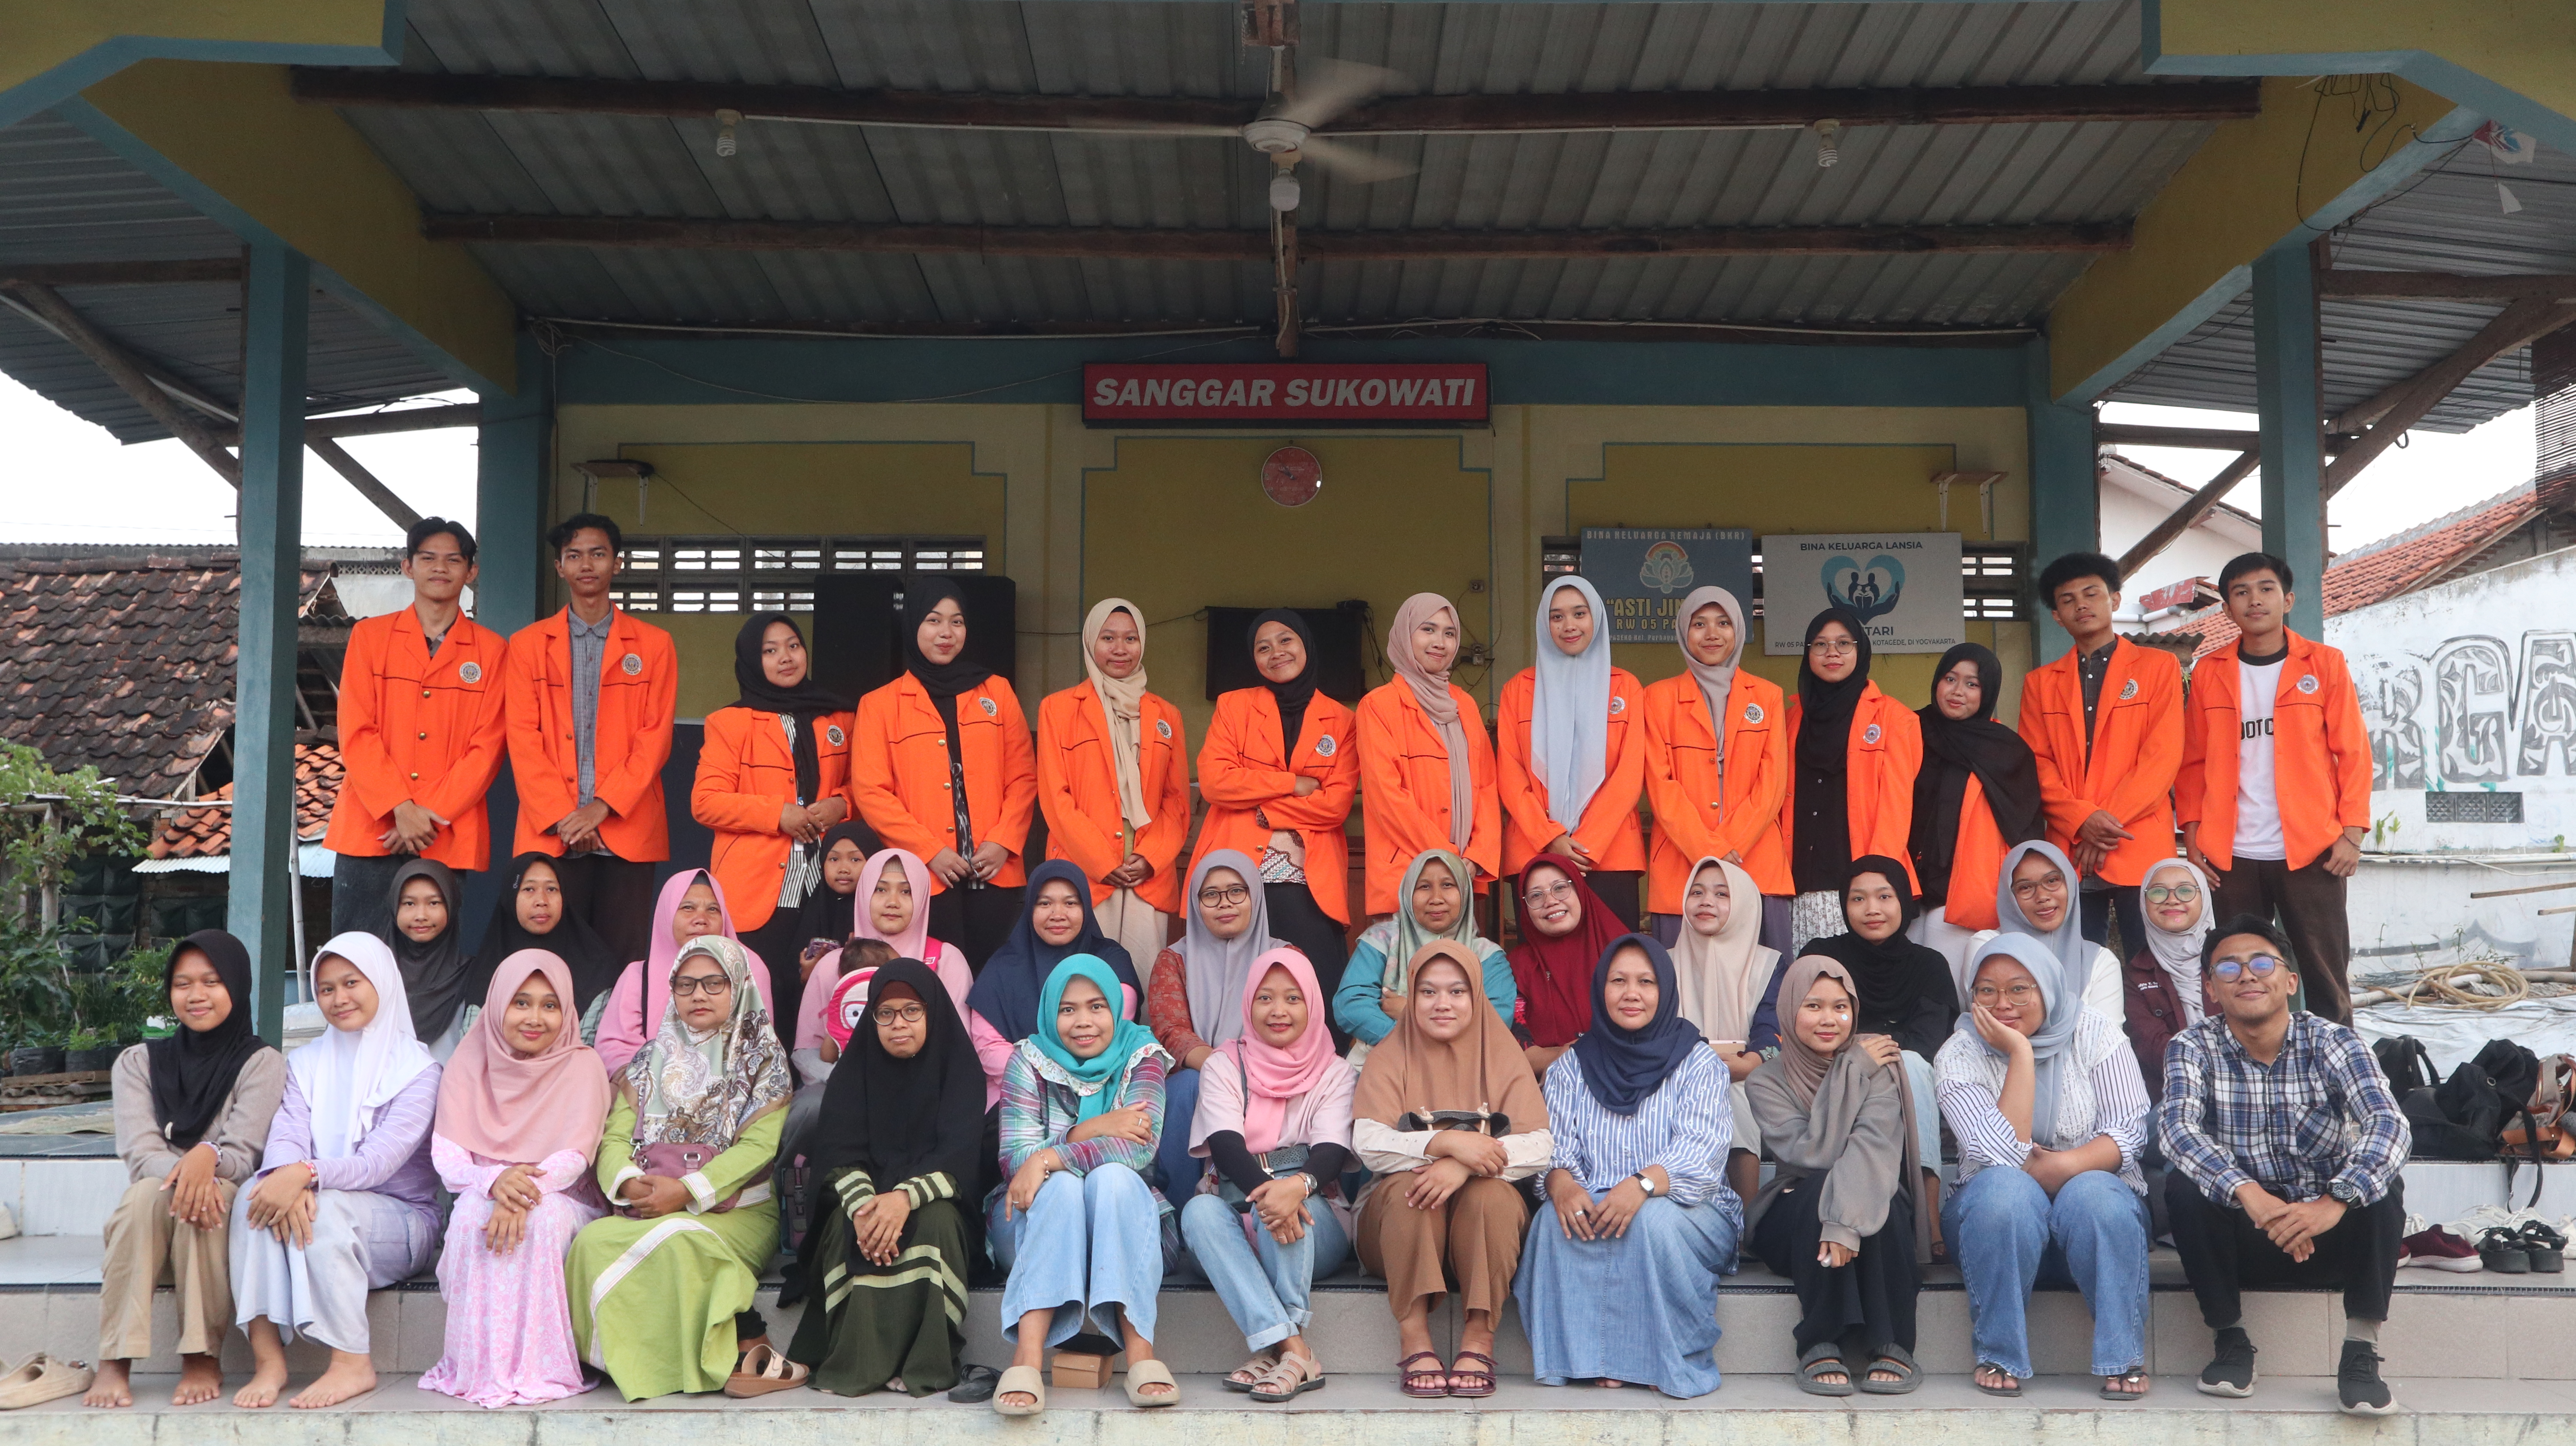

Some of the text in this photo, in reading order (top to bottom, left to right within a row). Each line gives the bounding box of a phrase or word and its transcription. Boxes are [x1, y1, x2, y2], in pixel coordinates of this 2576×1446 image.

[1093, 378, 1475, 407] SANGGAR SUKOWATI
[1587, 531, 1745, 540] BINA KELUARGA REMAJA (BKR)
[1800, 541, 1923, 551] BINA KELUARGA LANSIA
[1616, 618, 1677, 630] RW 05 PA
[1862, 626, 1893, 636] TARI
